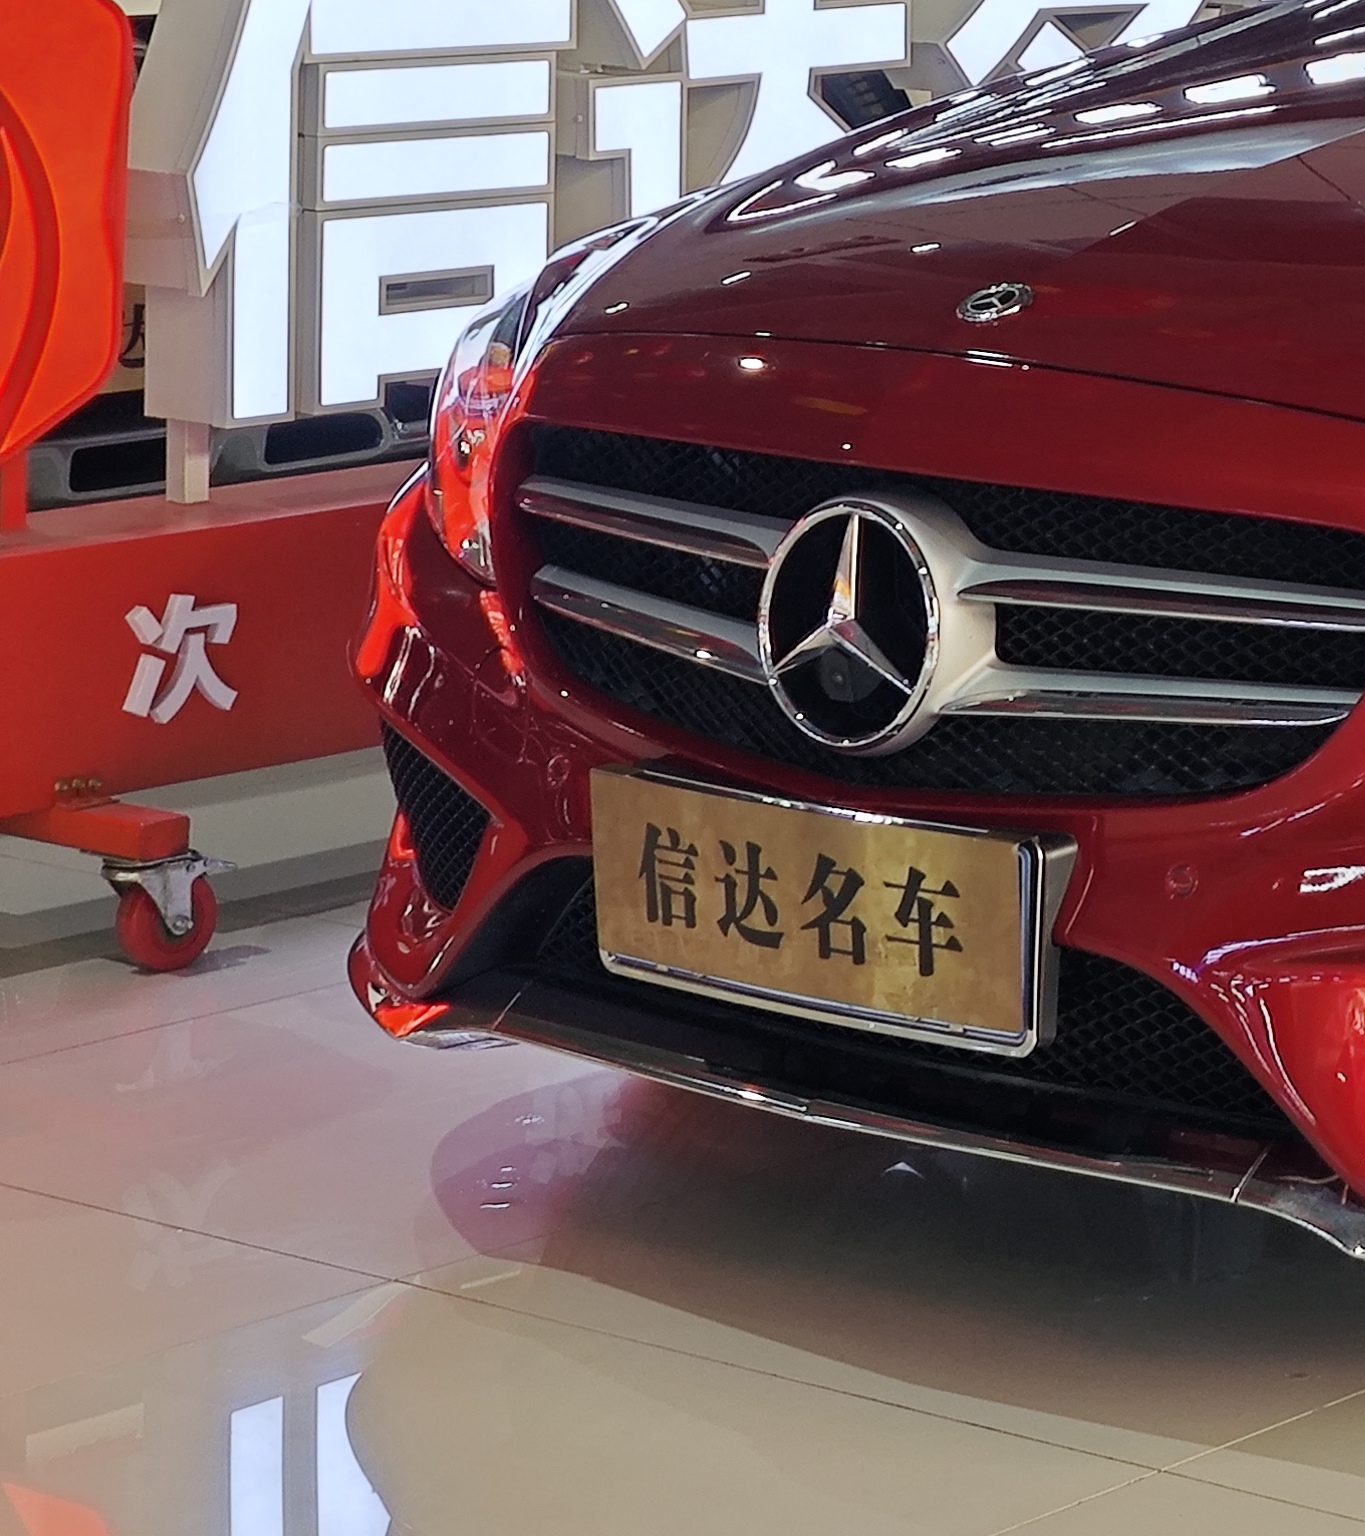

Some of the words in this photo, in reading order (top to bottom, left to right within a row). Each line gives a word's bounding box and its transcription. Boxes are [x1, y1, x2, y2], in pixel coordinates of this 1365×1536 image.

[122, 594, 239, 726] 次
[638, 822, 963, 977] 信达名车
